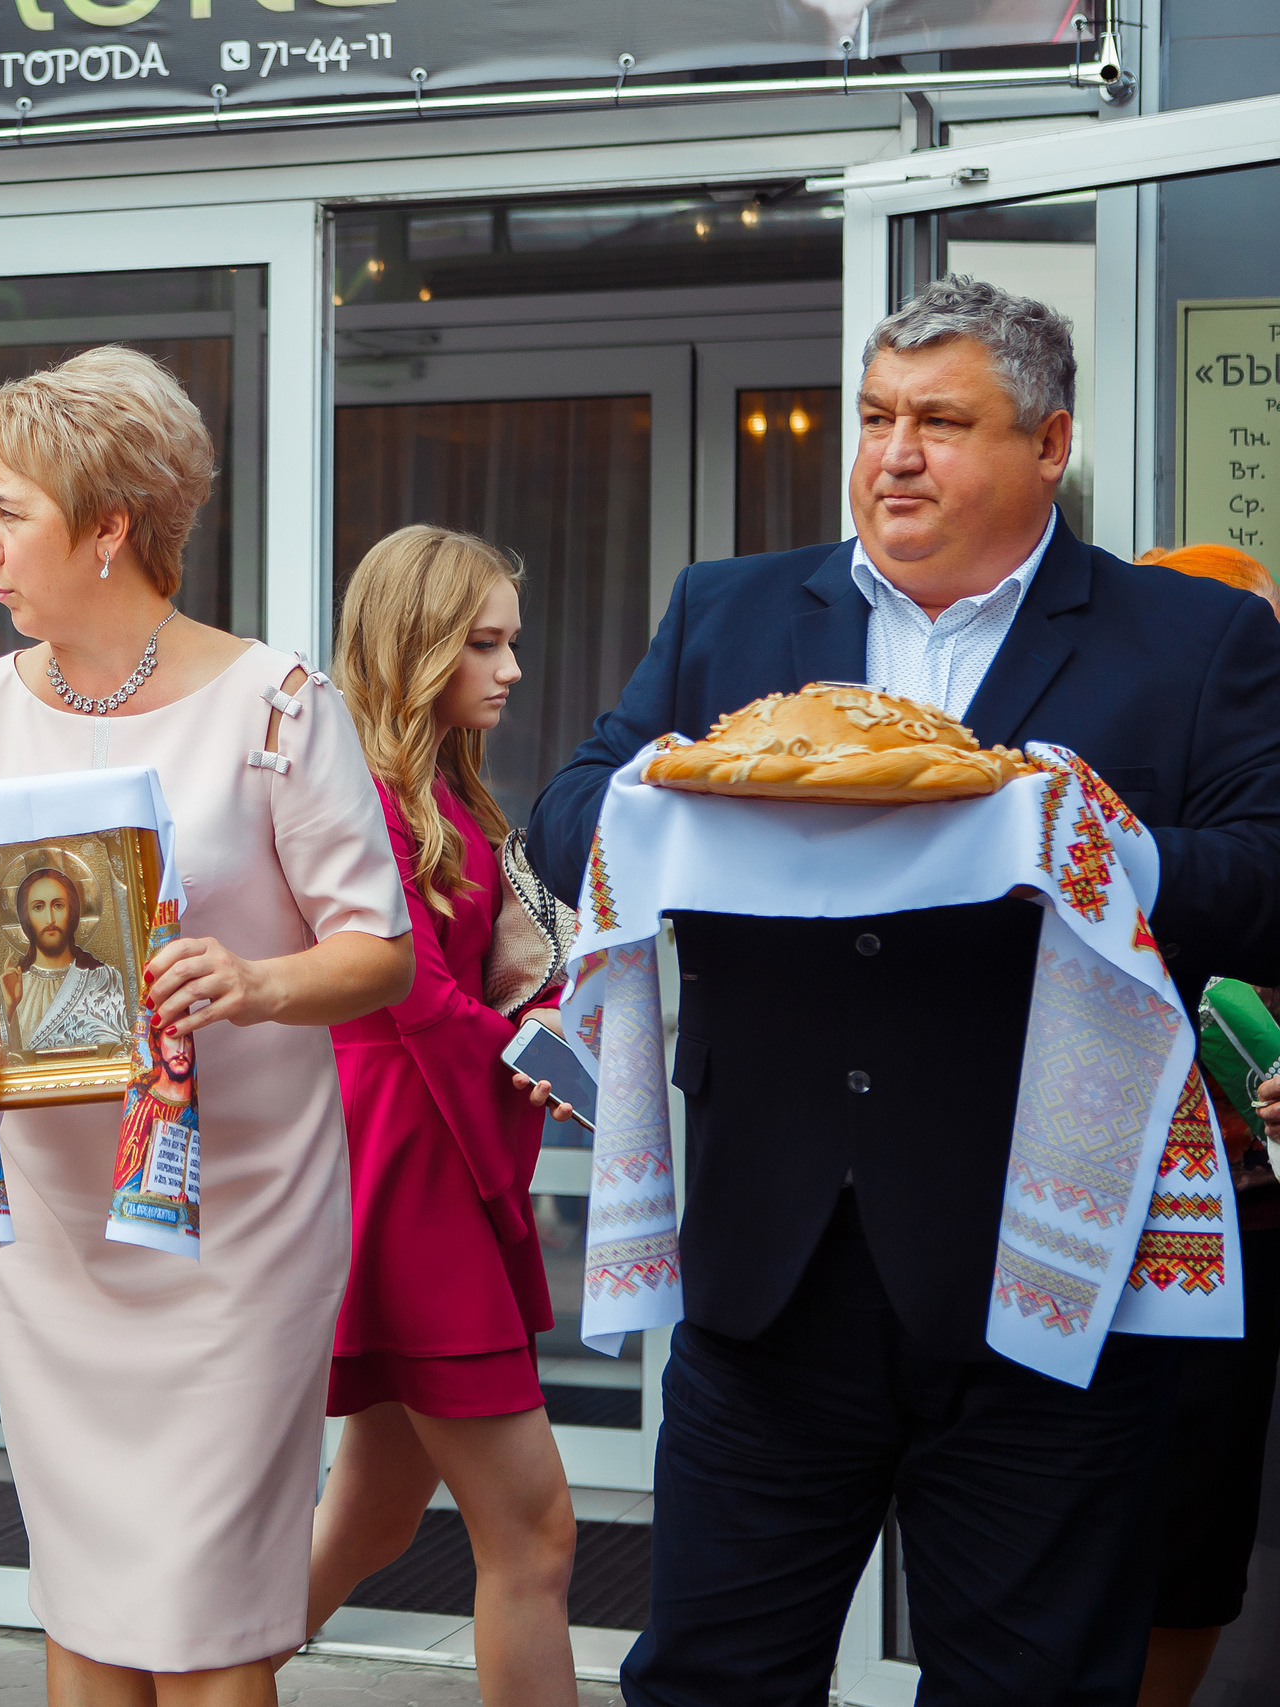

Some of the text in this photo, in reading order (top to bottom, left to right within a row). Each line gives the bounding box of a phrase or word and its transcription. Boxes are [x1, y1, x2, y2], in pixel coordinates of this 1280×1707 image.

[257, 31, 394, 79] 71-44-11
[1229, 427, 1271, 447] Пн.
[1229, 461, 1266, 480] Вт.
[1228, 493, 1266, 519] Ср.
[1228, 527, 1264, 547] Чт.
